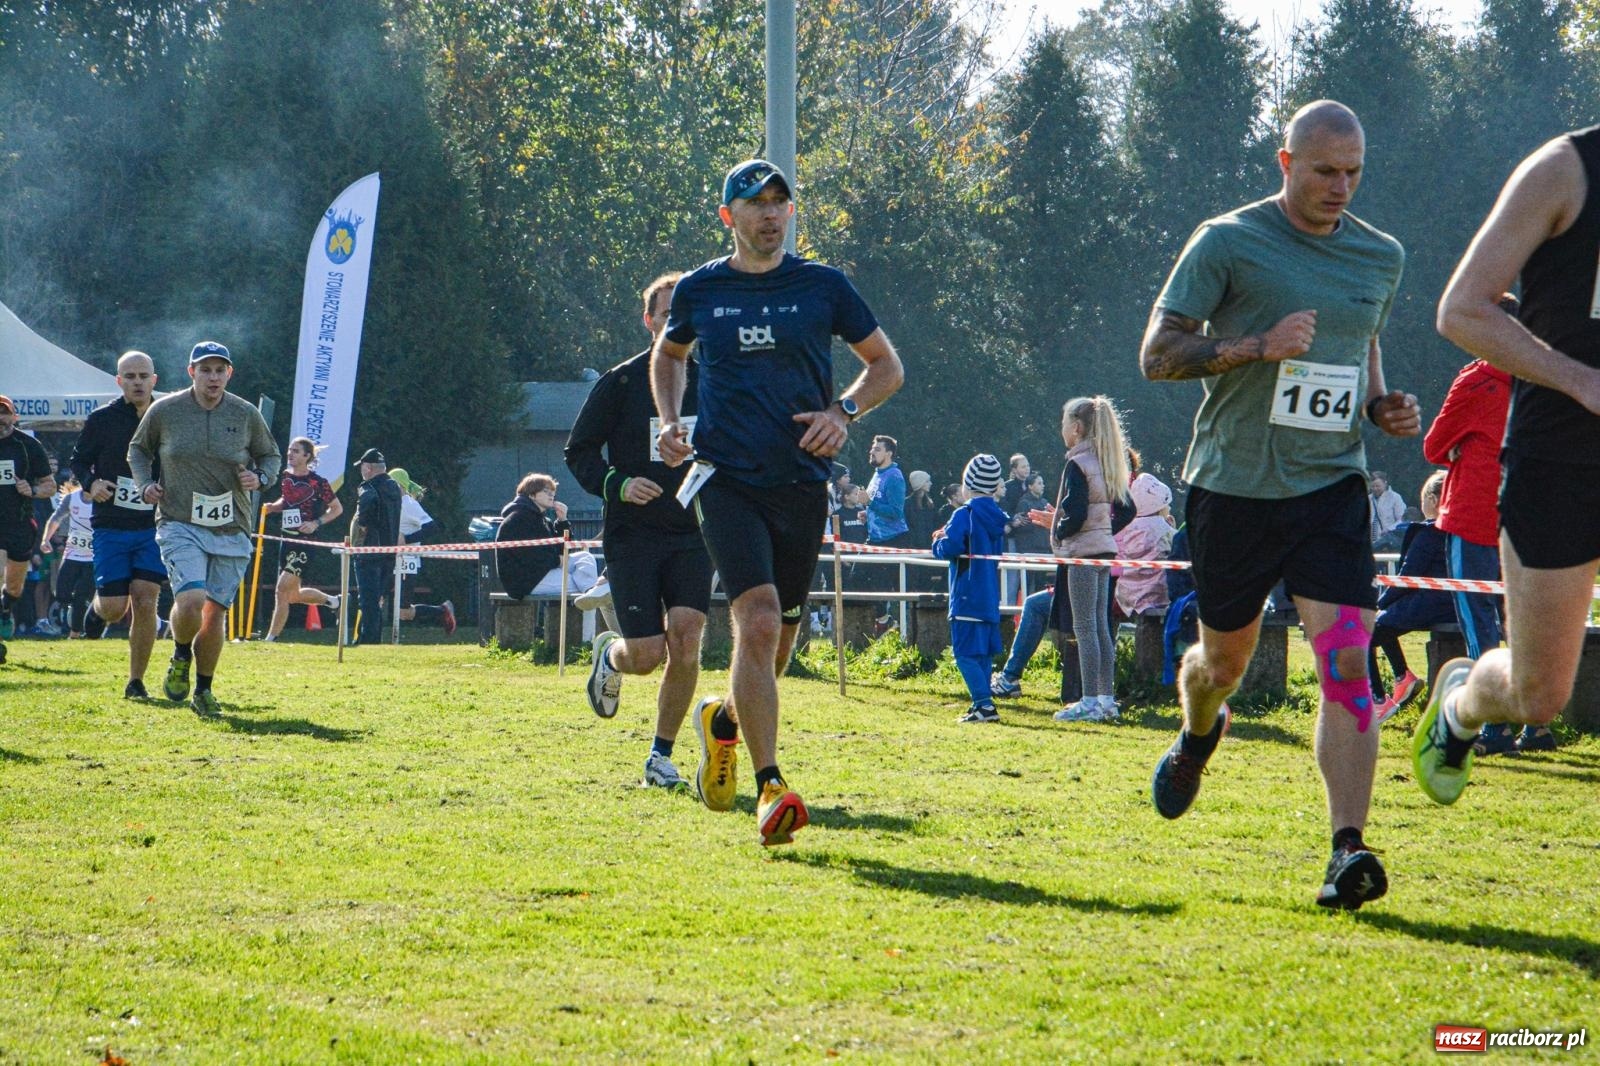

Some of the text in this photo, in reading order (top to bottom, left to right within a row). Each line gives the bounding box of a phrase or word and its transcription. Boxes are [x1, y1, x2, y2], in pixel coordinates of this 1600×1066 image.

[319, 271, 344, 342] STOWARZYSZENIE
[314, 343, 333, 382] AKTYWNI
[310, 383, 328, 400] DLA
[1282, 384, 1352, 420] 164
[0, 469, 13, 481] 5
[195, 503, 231, 521] 148
[283, 516, 300, 526] 150
